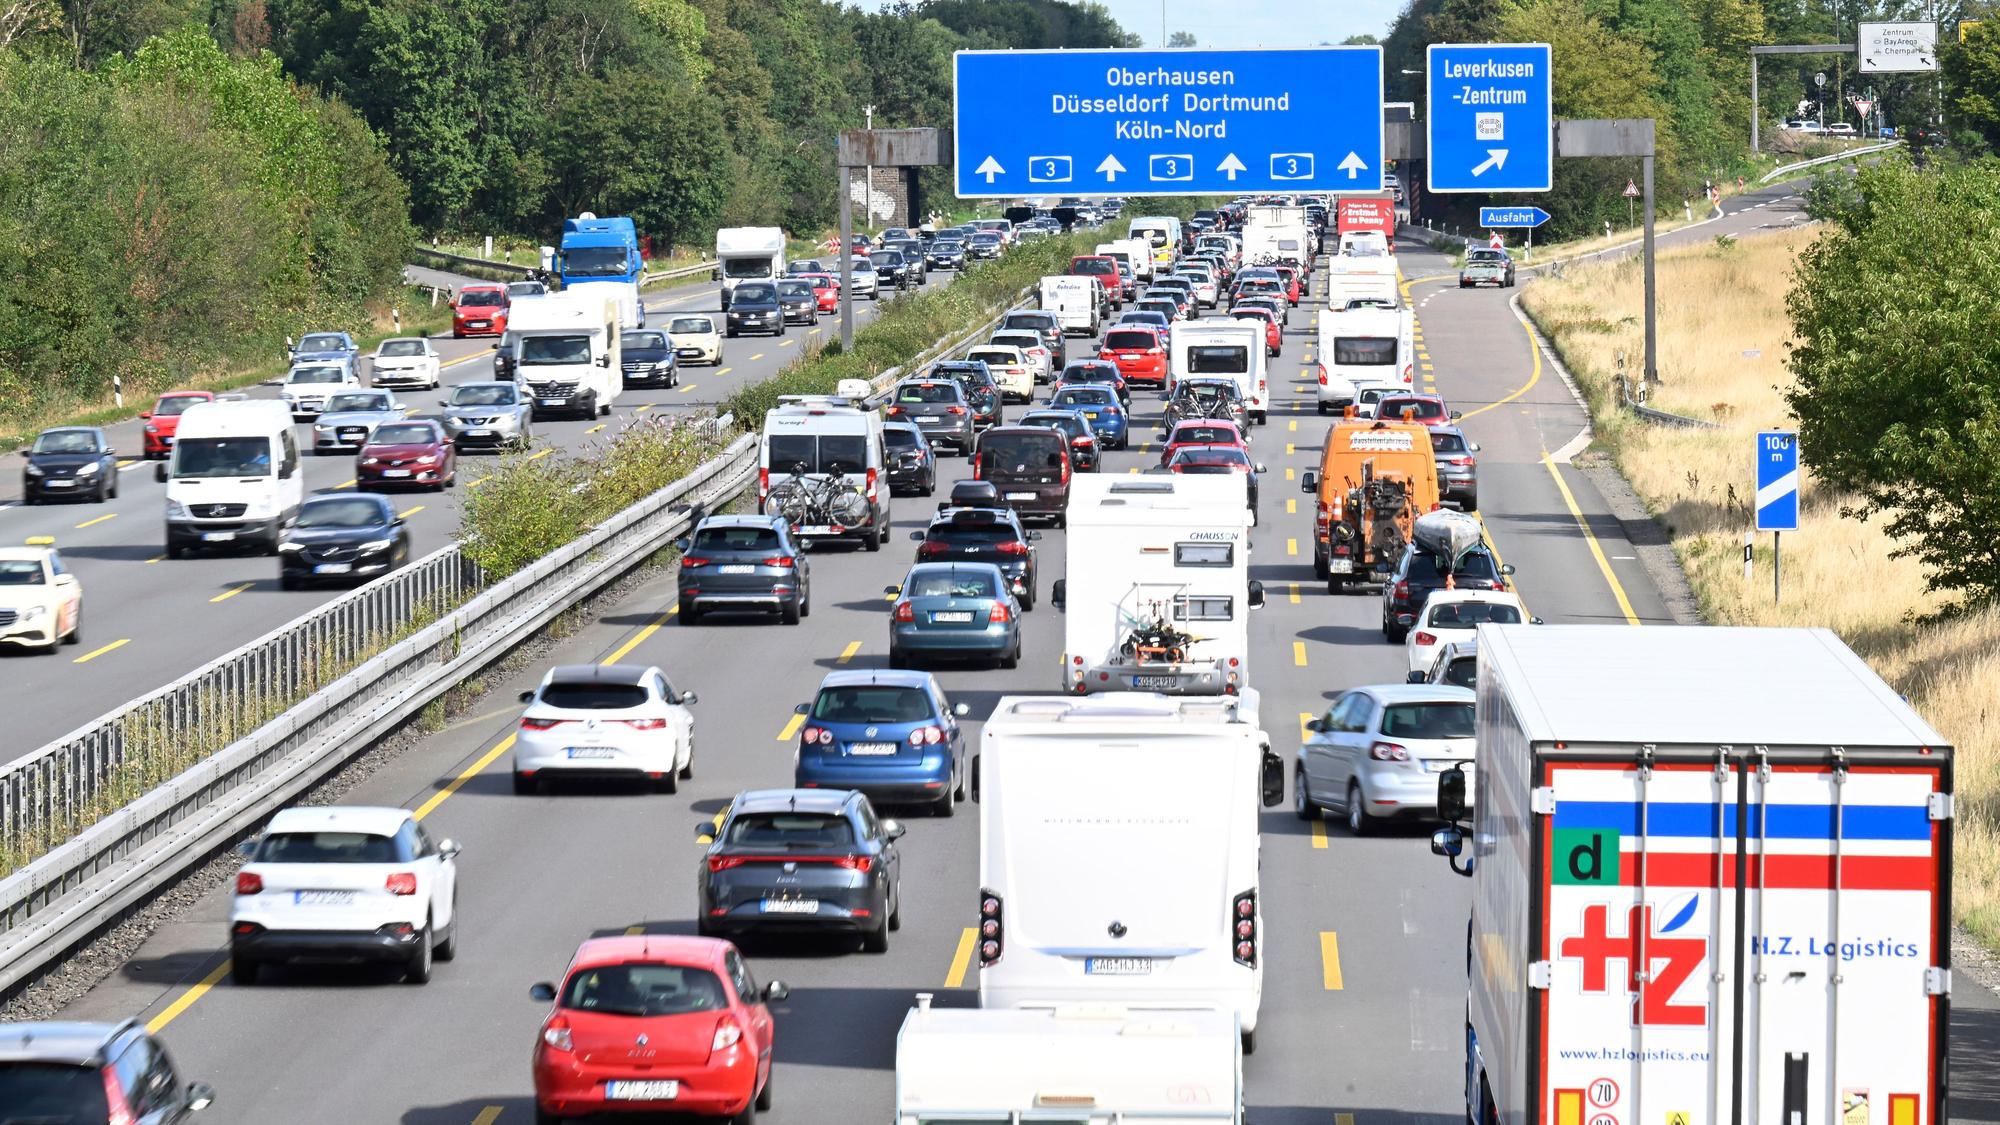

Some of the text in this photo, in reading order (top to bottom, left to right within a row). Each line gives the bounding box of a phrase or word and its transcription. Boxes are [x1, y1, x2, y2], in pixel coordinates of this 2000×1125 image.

[1106, 66, 1235, 87] Oberhausen
[1444, 59, 1534, 78] Leverkusen
[1052, 92, 1290, 114] Düsseldorf Dortmund
[1453, 86, 1527, 105] -Zentrum
[1115, 119, 1227, 140] Köln-Nord
[1045, 161, 1057, 178] 3
[1166, 160, 1177, 176] 3
[1287, 158, 1298, 174] 3
[1359, 217, 1384, 225] Penny
[1488, 212, 1535, 223] Ausfahrt
[1765, 436, 1789, 450] 100
[1772, 453, 1783, 462] m
[1189, 532, 1239, 540] CHAUSSON
[1567, 834, 1603, 880] d
[1752, 936, 1918, 960] H.Z. Logistics
[1559, 1047, 1710, 1063] www.hzlogistics.eu
[1596, 1083, 1612, 1103] 70
